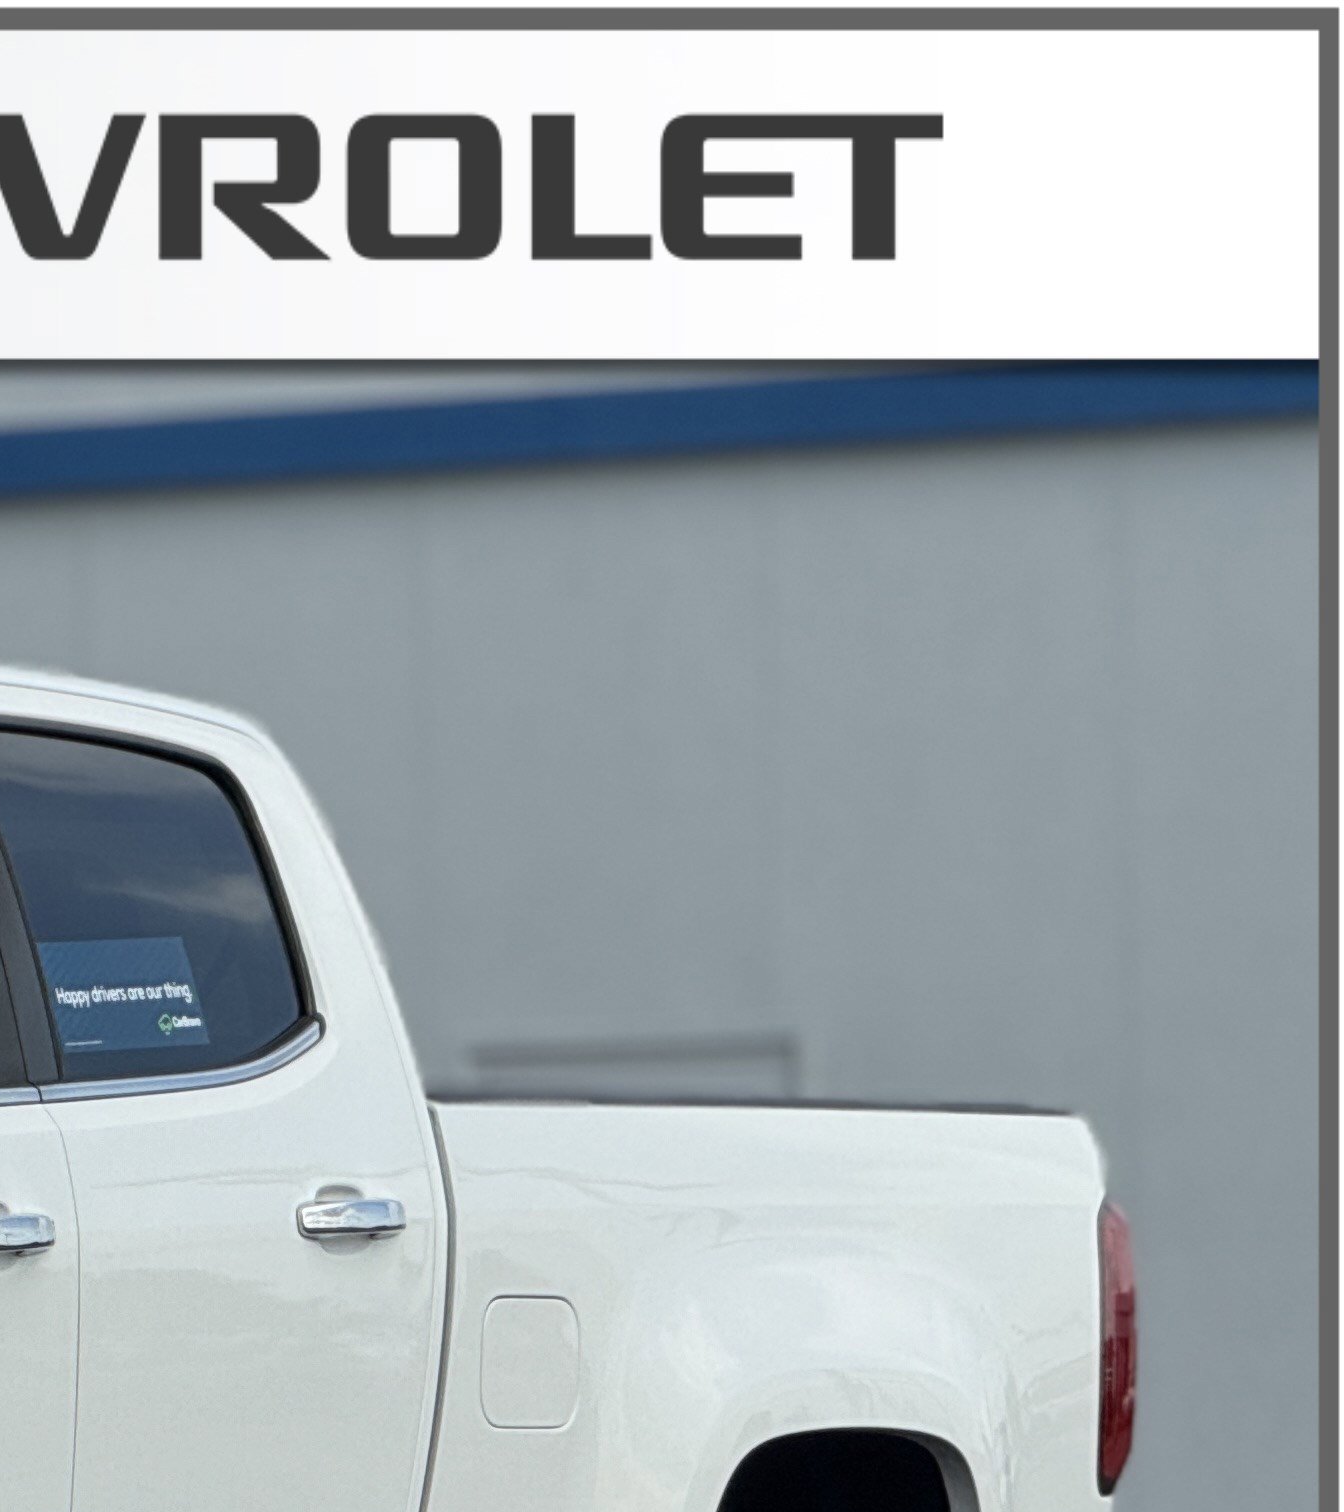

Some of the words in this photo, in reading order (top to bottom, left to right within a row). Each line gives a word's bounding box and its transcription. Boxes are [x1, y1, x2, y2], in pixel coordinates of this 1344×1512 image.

[55, 987, 90, 1008] Happy
[91, 985, 127, 1003] drivers
[127, 986, 145, 1001] are
[146, 985, 163, 1000] our
